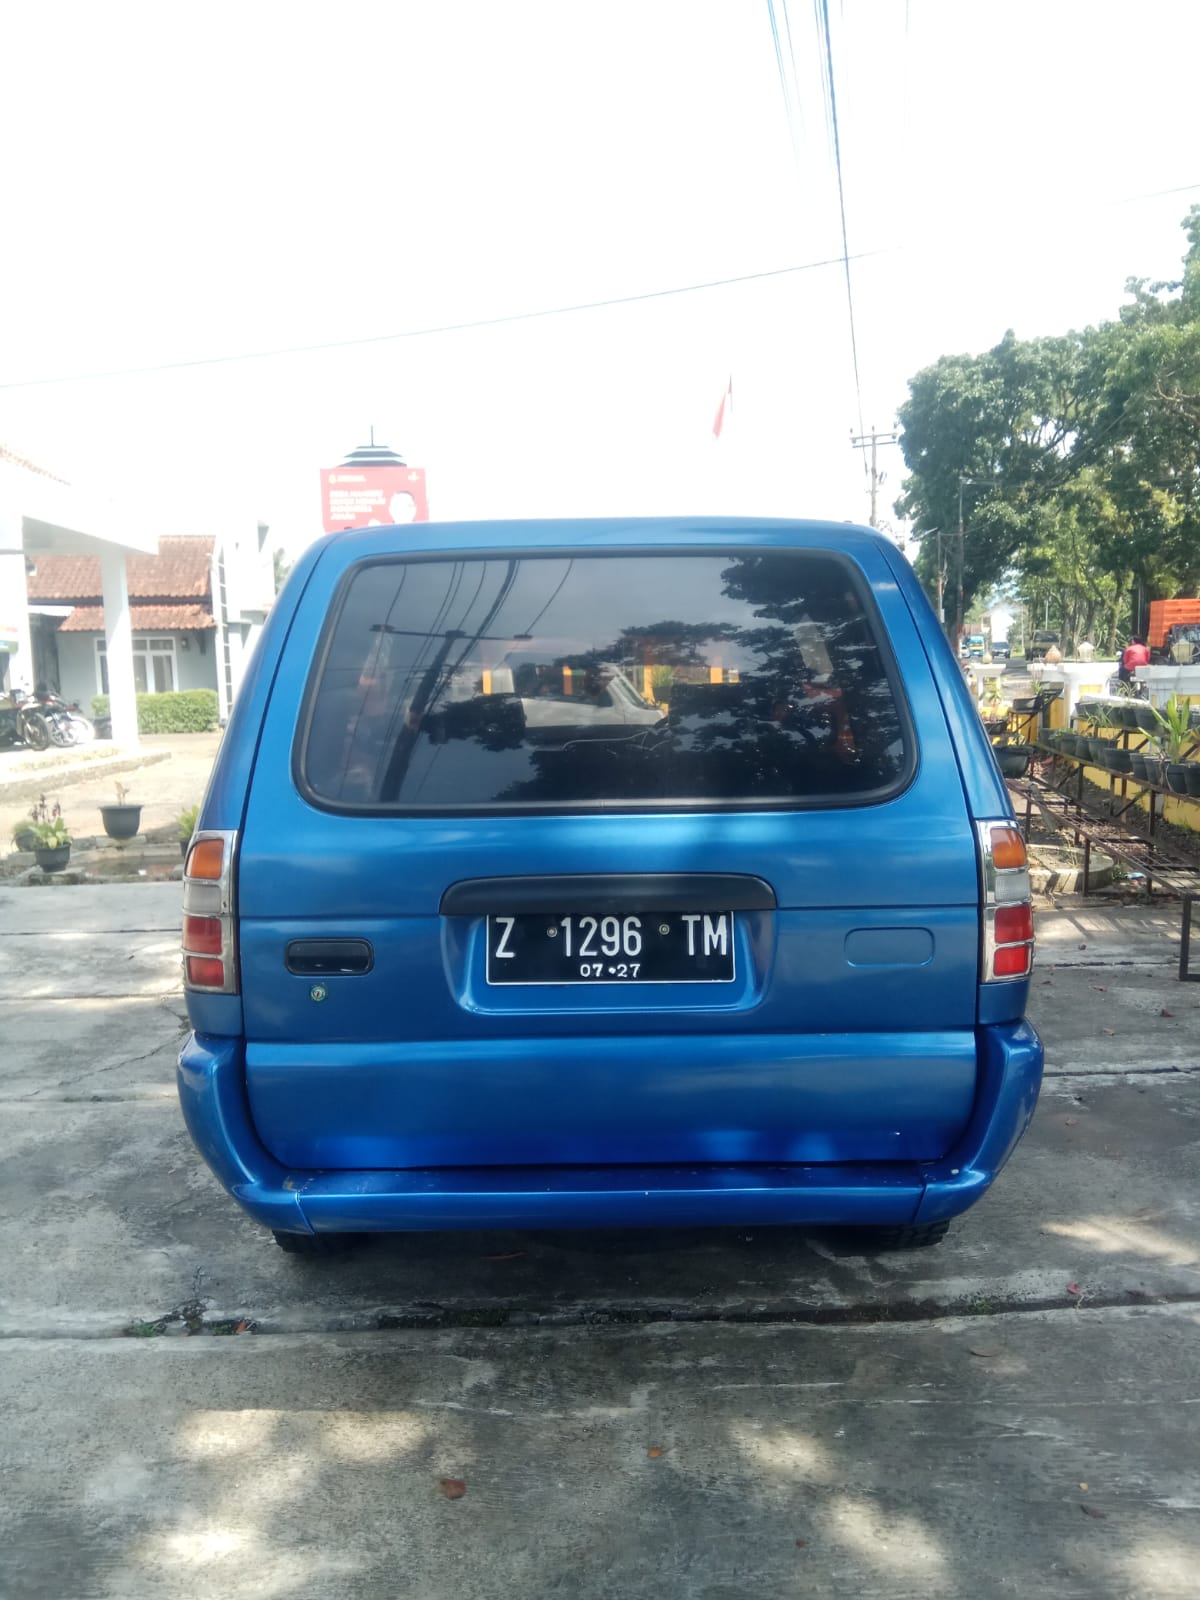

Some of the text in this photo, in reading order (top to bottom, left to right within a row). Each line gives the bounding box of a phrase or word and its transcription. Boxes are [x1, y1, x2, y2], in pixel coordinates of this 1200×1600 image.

[495, 914, 728, 959] Z 1296 TM
